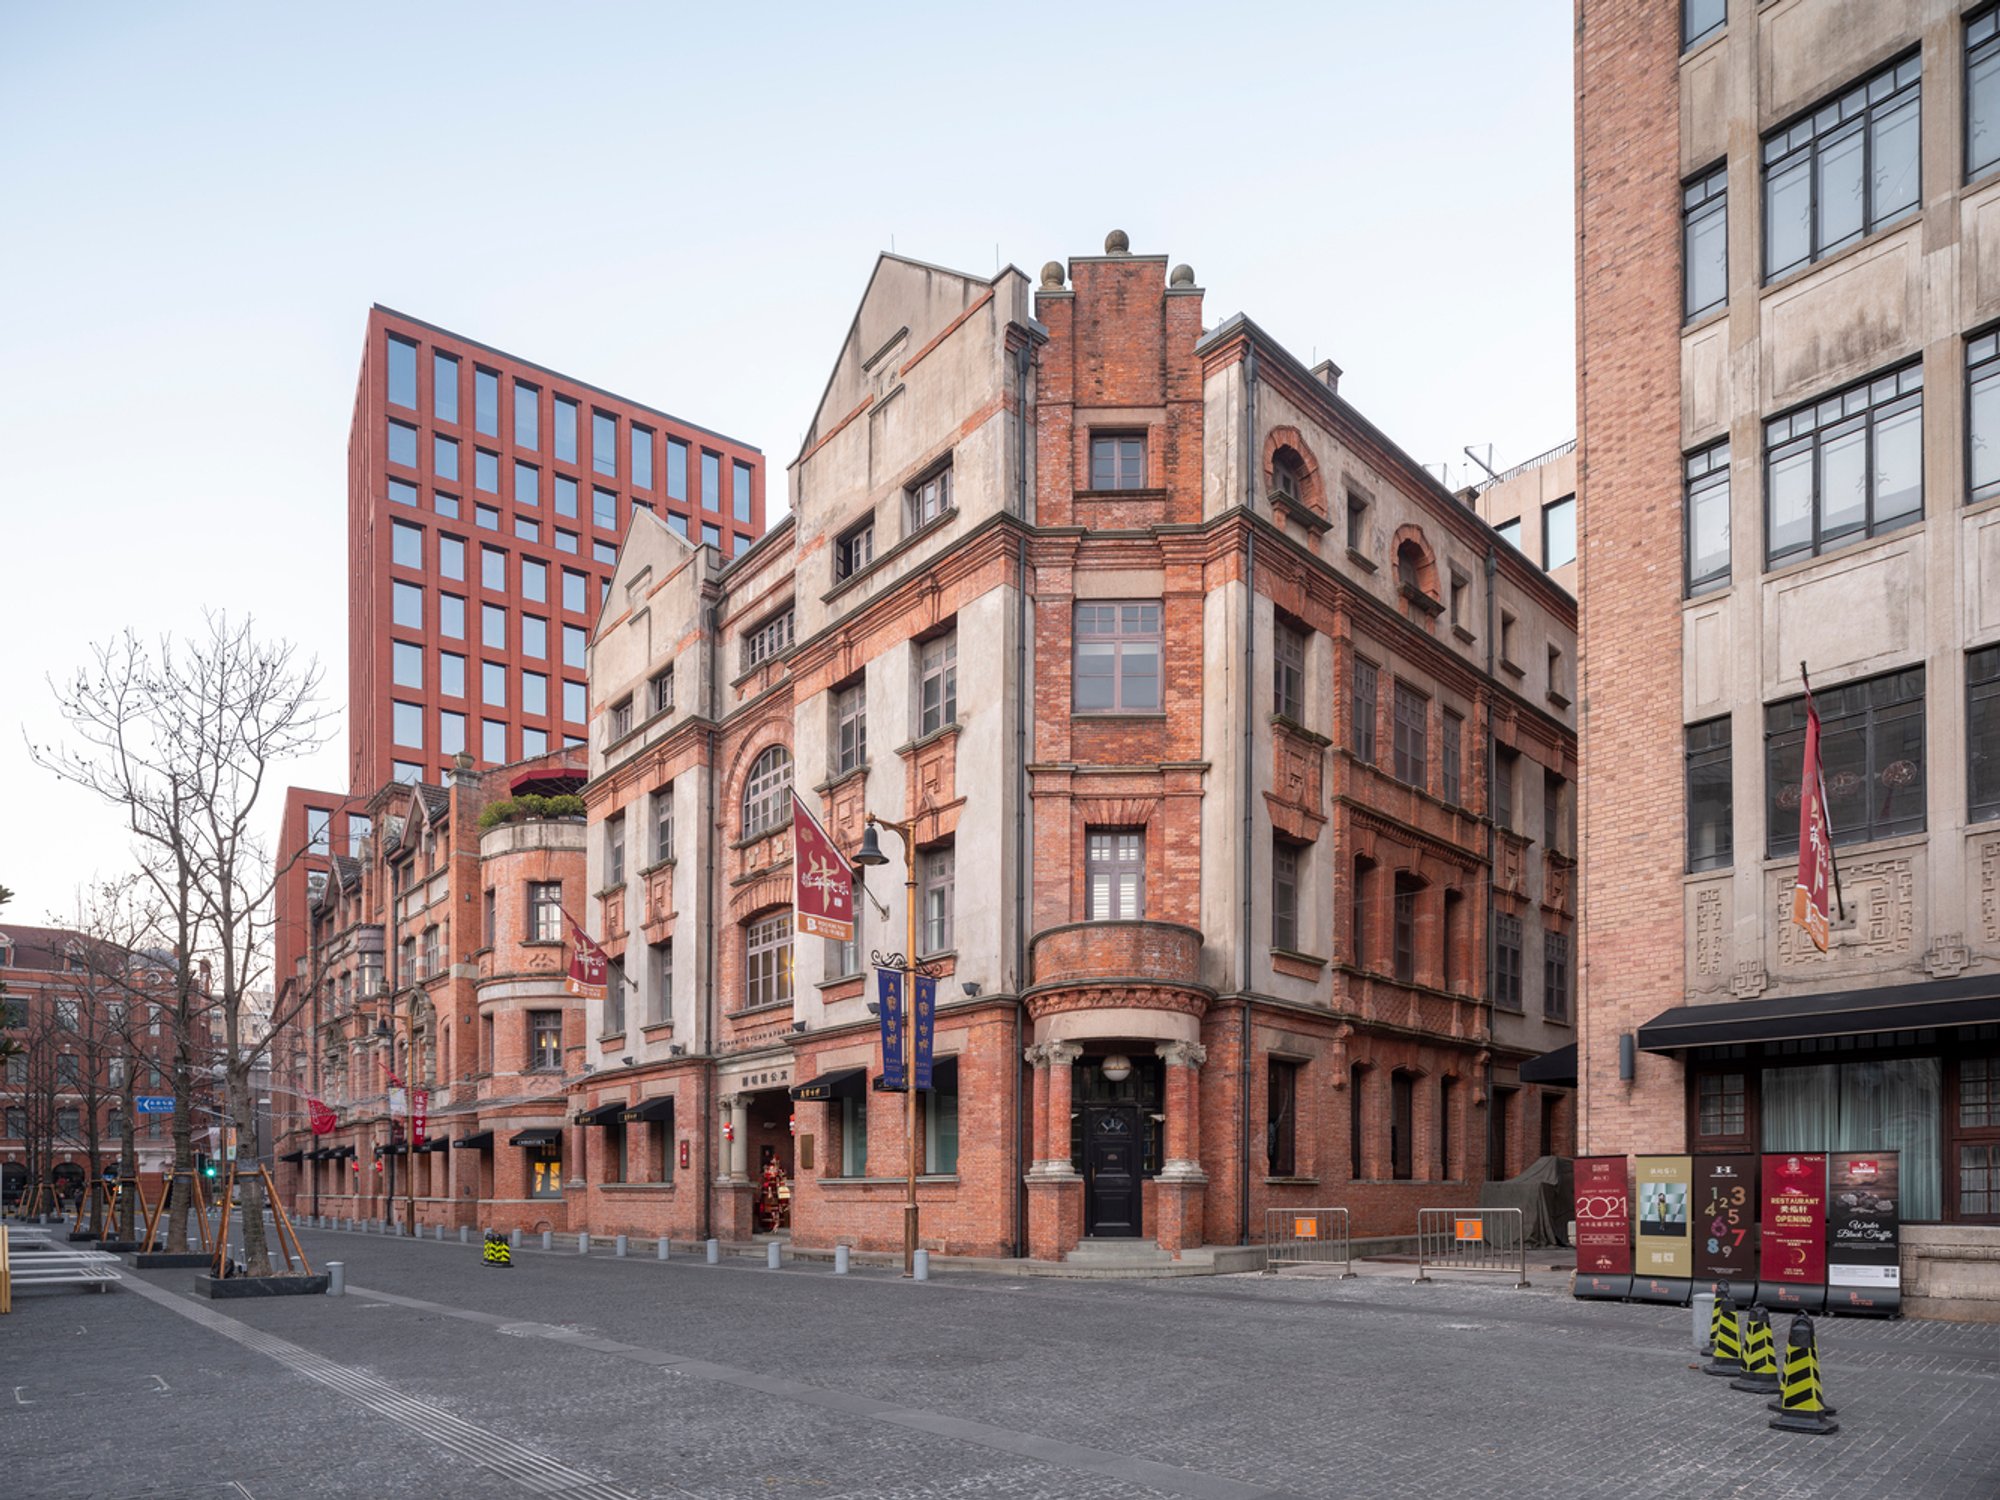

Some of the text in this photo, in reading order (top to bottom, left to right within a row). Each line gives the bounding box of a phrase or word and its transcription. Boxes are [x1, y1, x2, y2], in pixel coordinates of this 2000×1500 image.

[1711, 1186, 1718, 1200] 1
[1730, 1186, 1746, 1206] 3
[1576, 1196, 1627, 1219] 2021
[1719, 1197, 1729, 1209] 2
[1770, 1197, 1819, 1205] RESTAURANT
[1704, 1201, 1717, 1217] 4
[1727, 1209, 1740, 1225] 5
[1775, 1215, 1813, 1223] OPENING
[1848, 1219, 1880, 1230] Winter
[1710, 1216, 1728, 1237] 6
[1731, 1229, 1747, 1247] 7
[1836, 1228, 1893, 1242] Black Truffle
[1707, 1237, 1719, 1254] 8
[1722, 1245, 1732, 1258] 9
